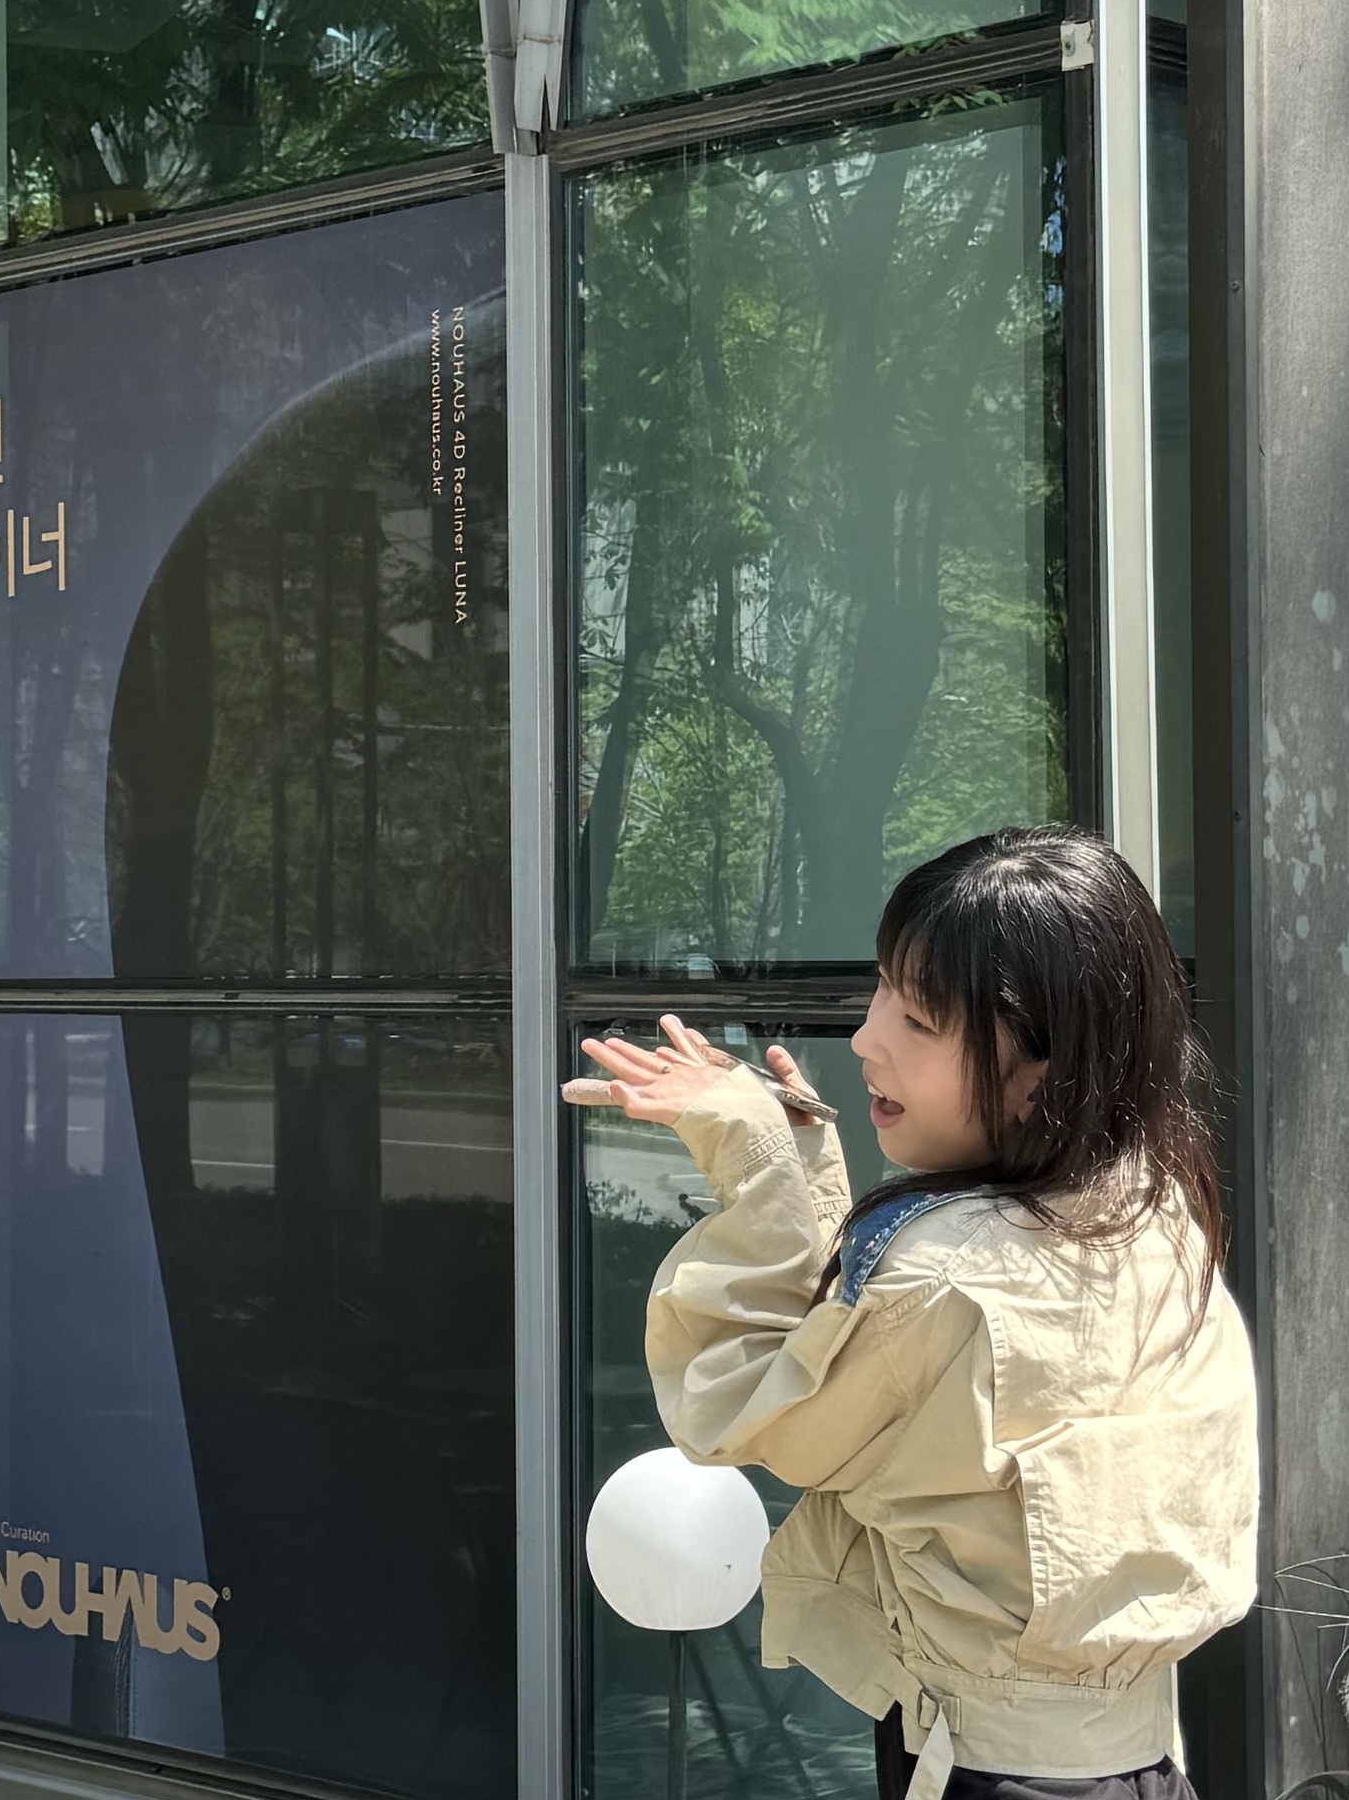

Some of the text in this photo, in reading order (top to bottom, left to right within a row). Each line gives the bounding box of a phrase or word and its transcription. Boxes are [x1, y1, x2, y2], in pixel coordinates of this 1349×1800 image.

[430, 308, 445, 496] www.nouhaus.co.kr
[452, 306, 468, 624] NOUHAUS 4D Recliner LUNA
[1, 1521, 50, 1544] Curation
